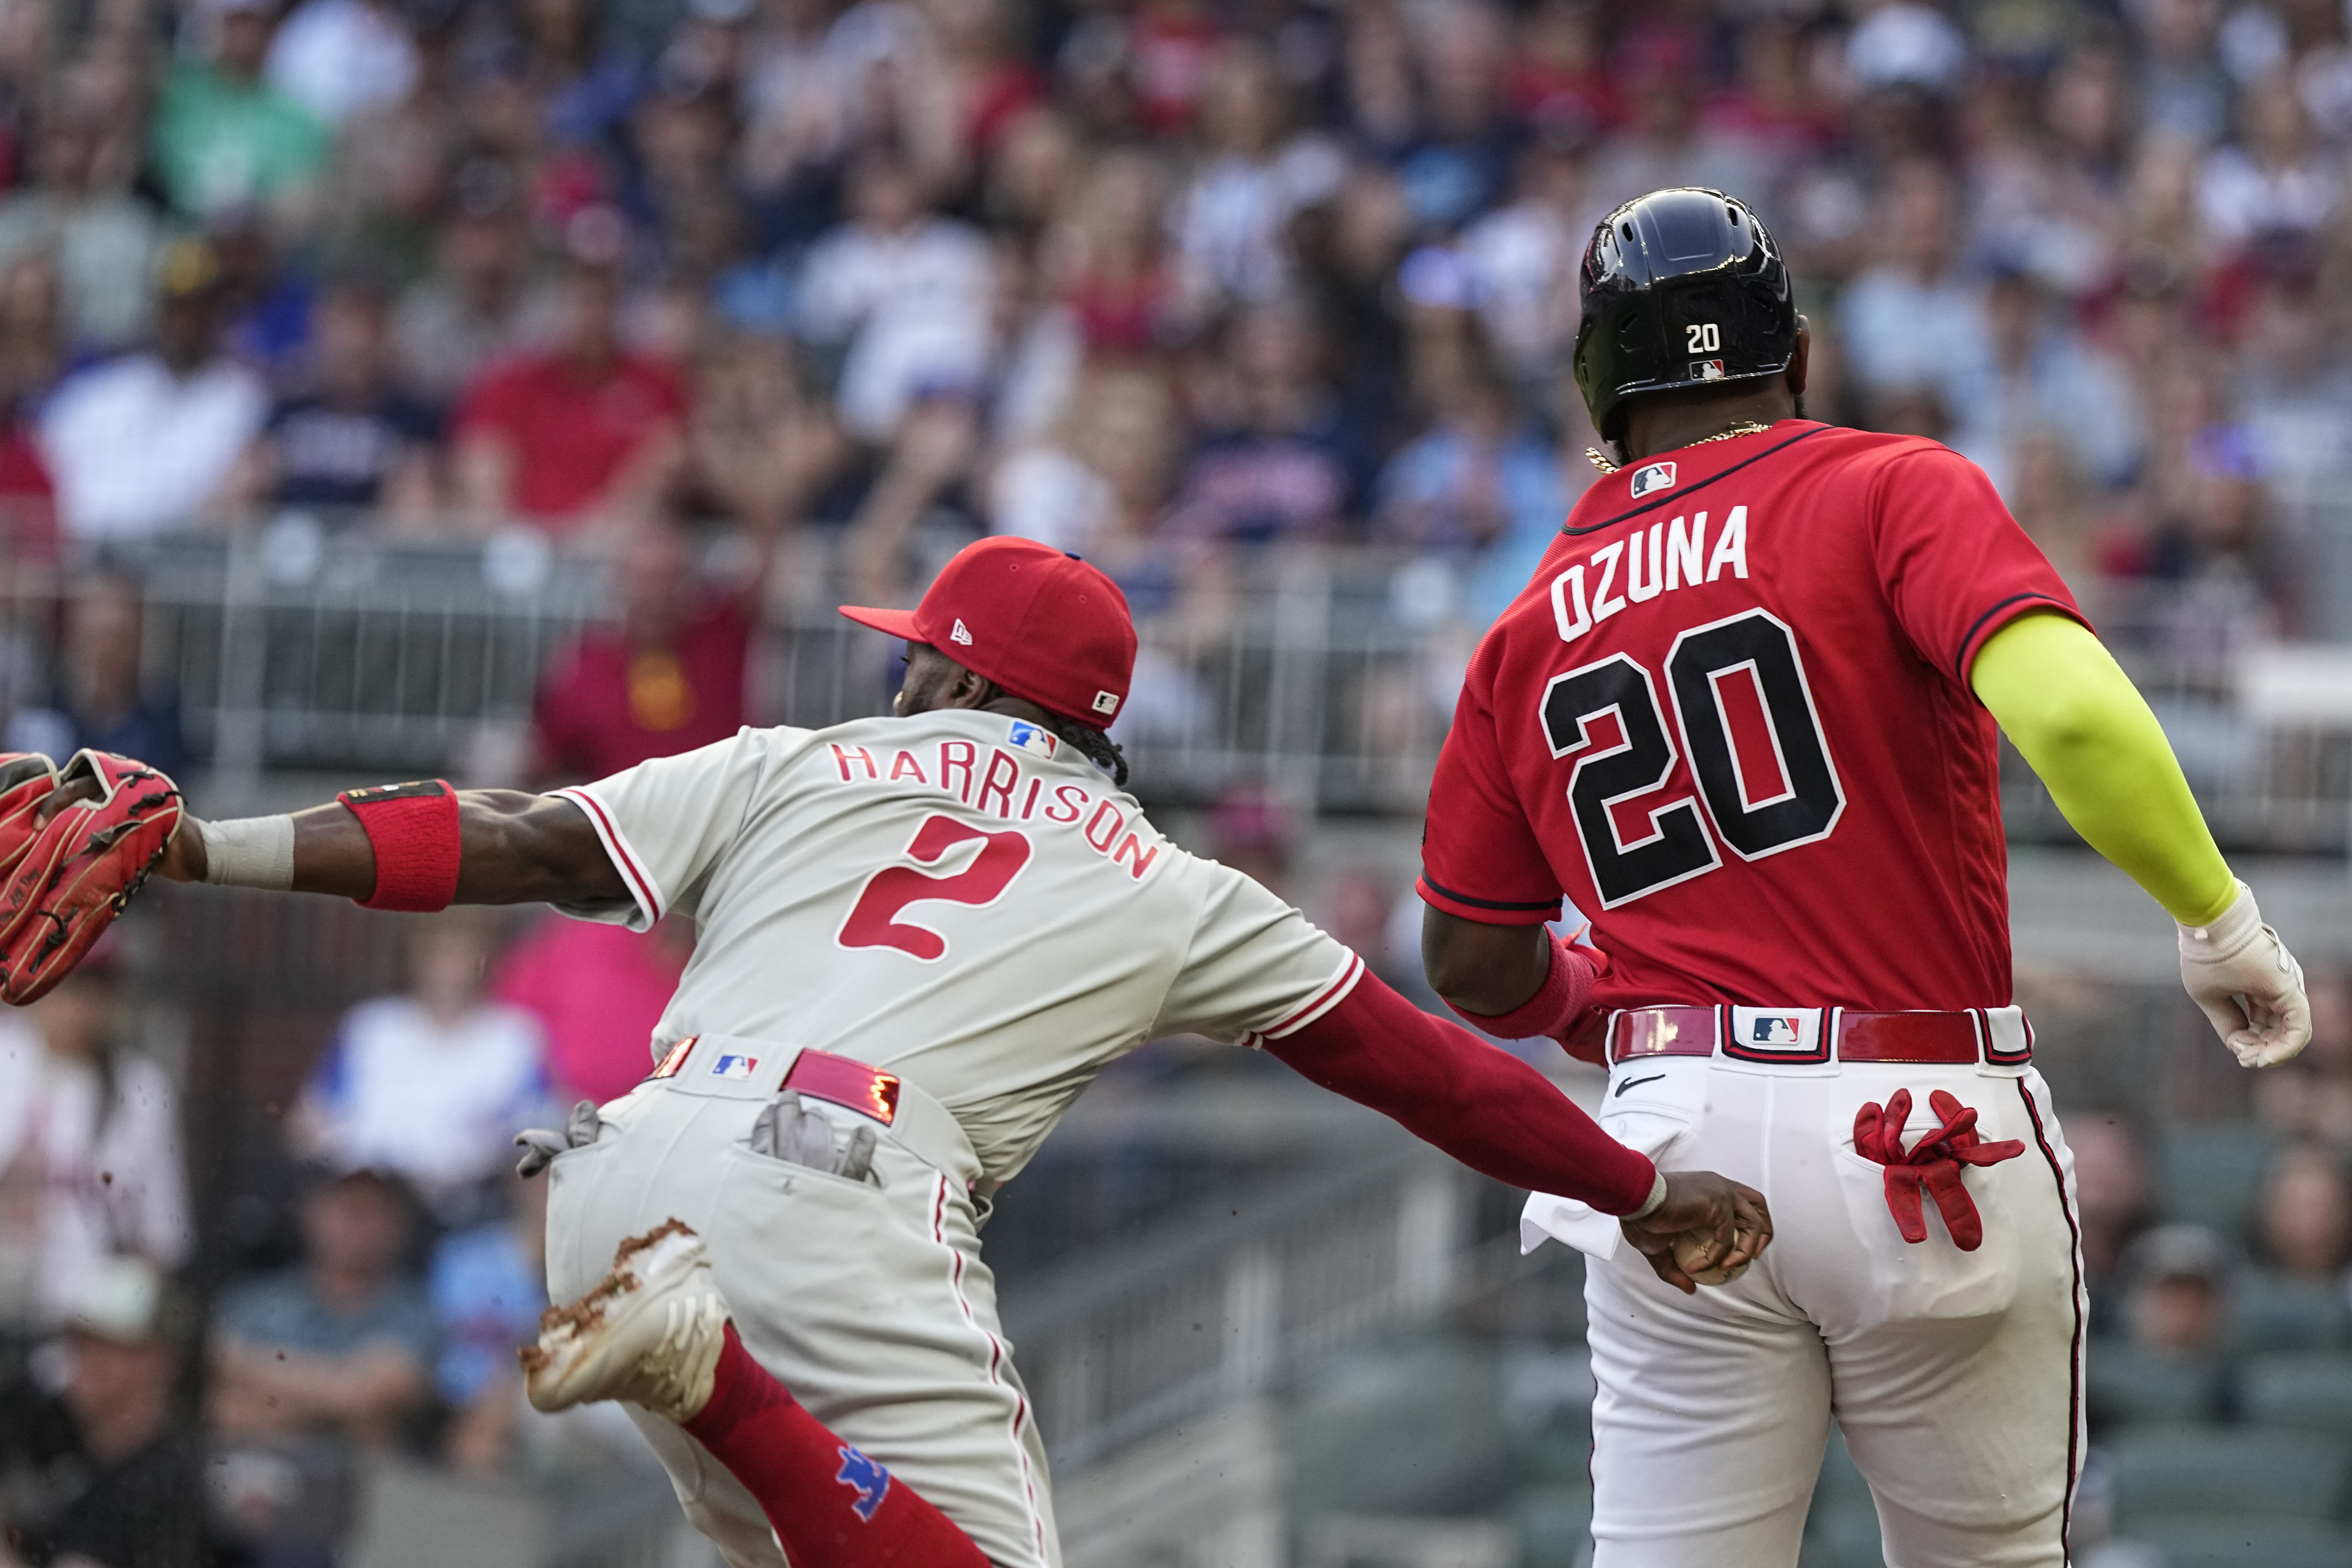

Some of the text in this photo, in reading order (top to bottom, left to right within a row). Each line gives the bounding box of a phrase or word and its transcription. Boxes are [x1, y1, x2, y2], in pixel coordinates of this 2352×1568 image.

[1686, 324, 1720, 354] 20
[1550, 505, 1749, 642] OZUNA
[827, 739, 1162, 883] HARRISON
[1539, 606, 1847, 910] 20
[834, 811, 1034, 964] 2
